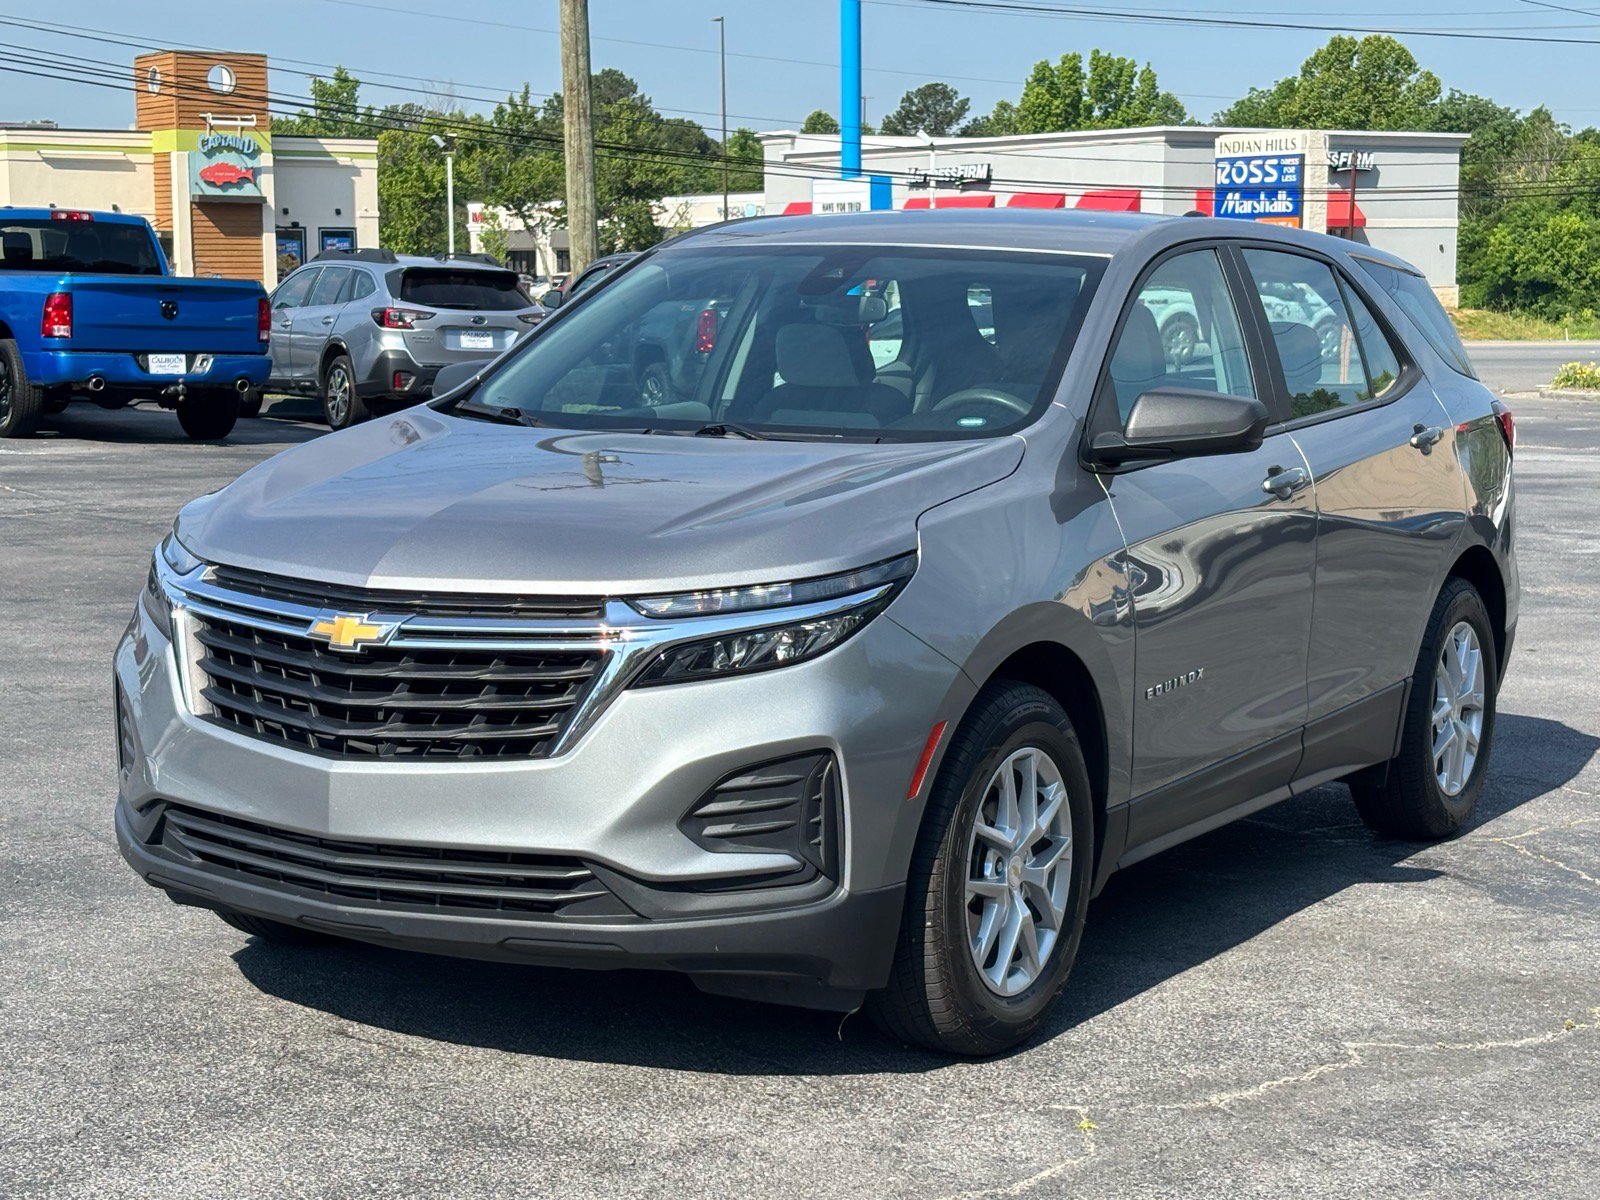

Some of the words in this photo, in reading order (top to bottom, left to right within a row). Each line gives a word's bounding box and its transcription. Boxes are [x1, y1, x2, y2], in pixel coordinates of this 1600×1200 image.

[198, 134, 243, 153] CAPTAIN
[1220, 140, 1262, 154] INDIAN
[1265, 137, 1297, 152] HILLS
[1216, 158, 1279, 185] ROSS
[1281, 174, 1297, 182] LESS
[1282, 166, 1296, 174] FOR
[1220, 190, 1293, 215] Marshalls
[1145, 667, 1204, 700] EQUINOX
